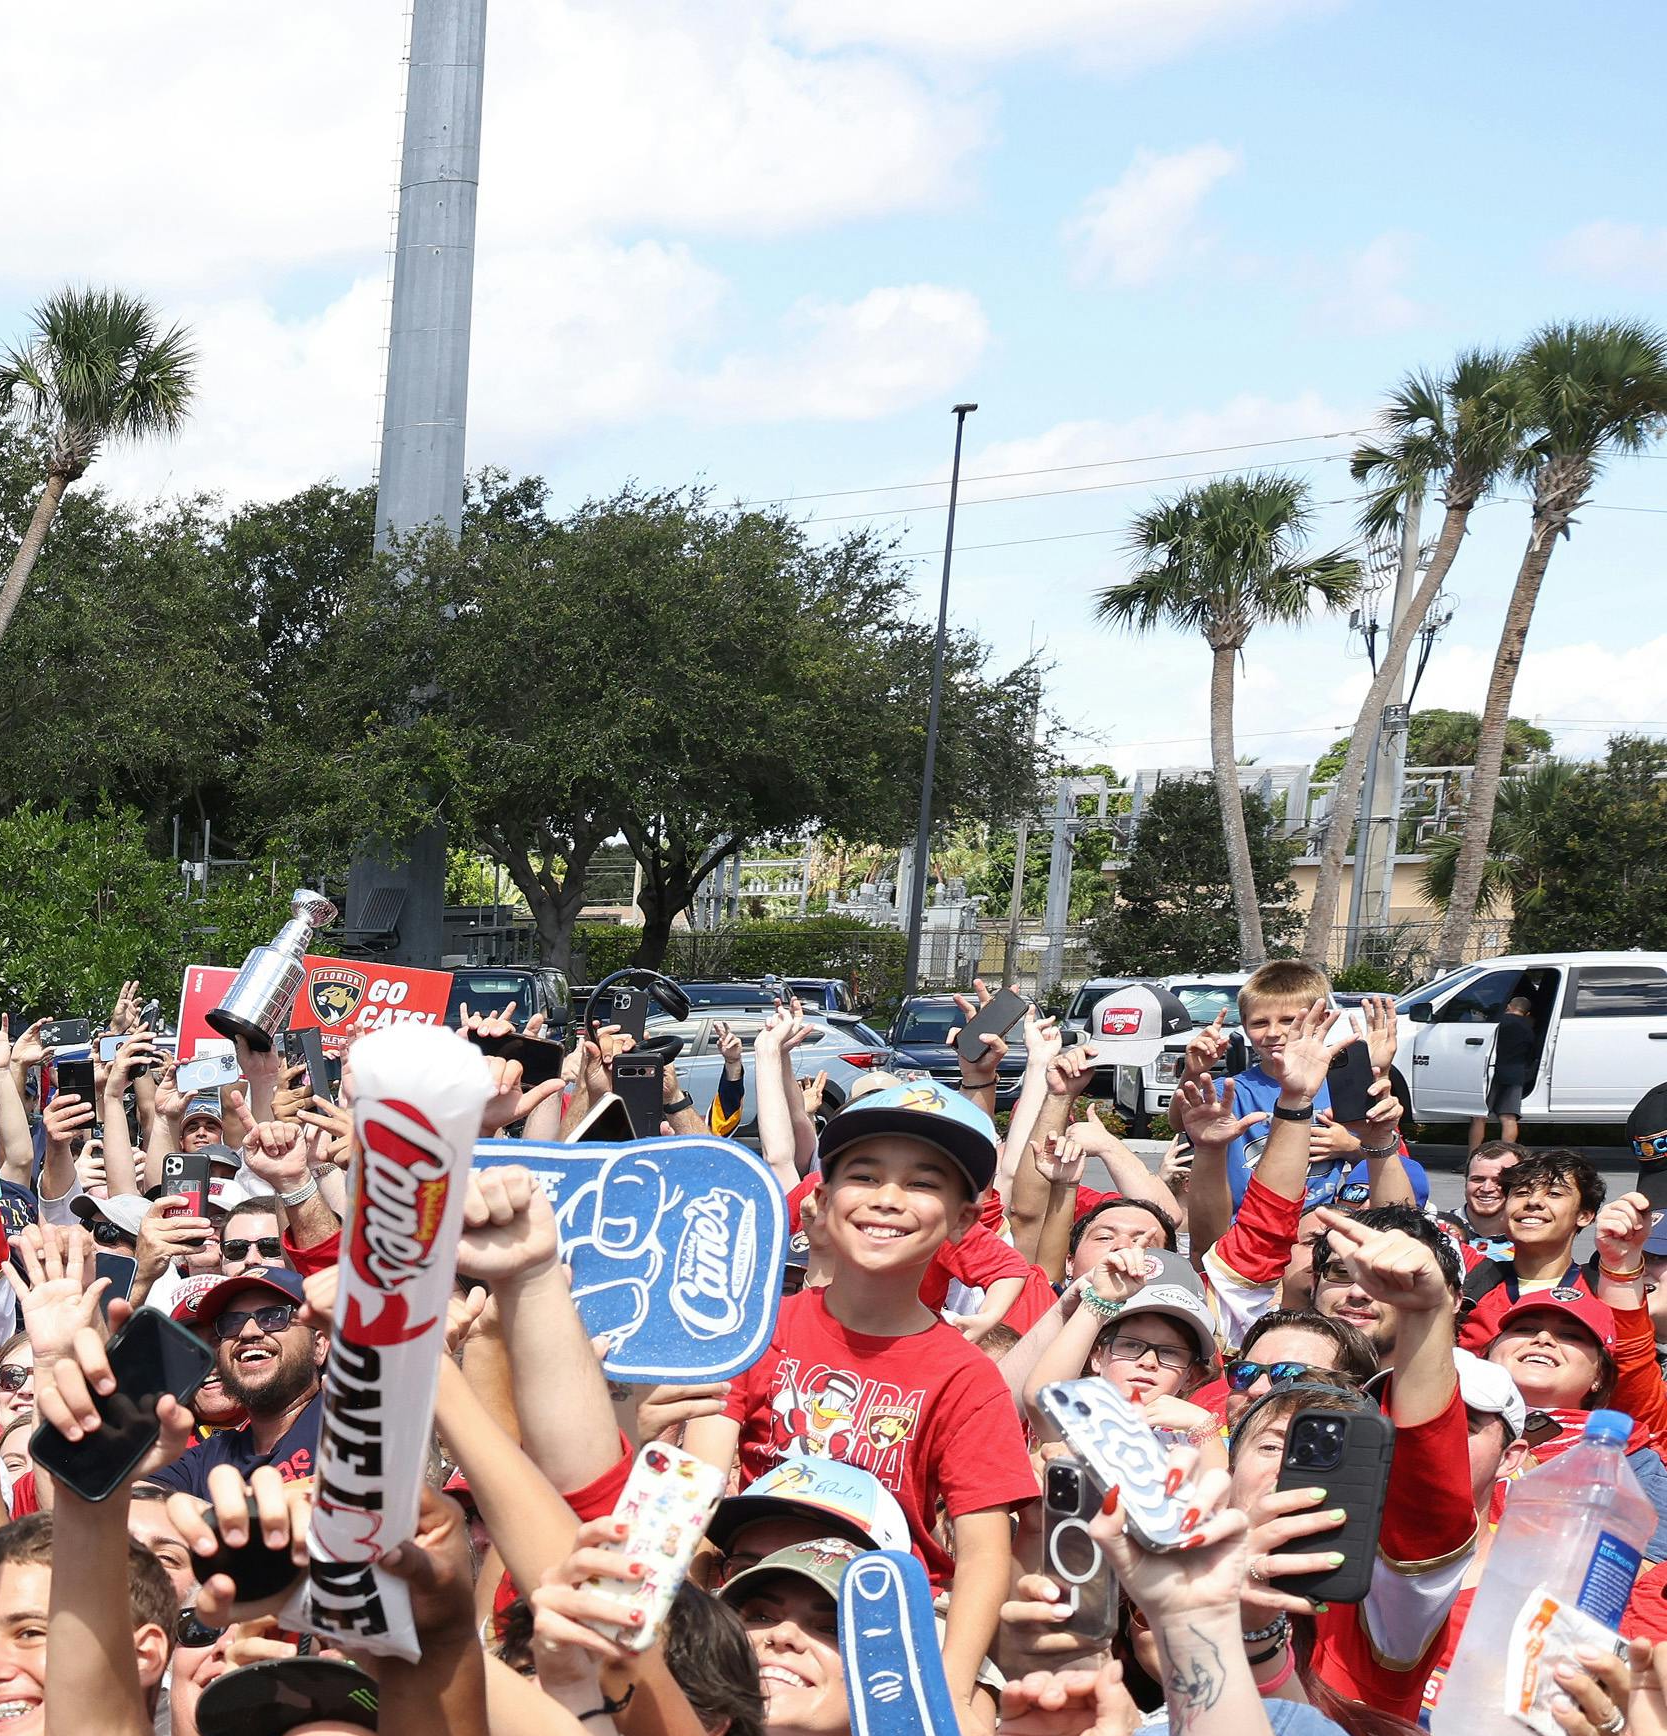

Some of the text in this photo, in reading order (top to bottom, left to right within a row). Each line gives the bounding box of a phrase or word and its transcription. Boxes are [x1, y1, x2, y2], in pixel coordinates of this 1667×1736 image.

[316, 971, 361, 985] FLORIDA
[367, 979, 410, 1004] GO
[354, 1098, 455, 1293] Cane's
[415, 1182, 446, 1242] Raising
[672, 1191, 738, 1333] Cane's
[679, 1231, 700, 1280] Raising
[1159, 1291, 1193, 1306] ALL OUT
[318, 1333, 383, 1477] ONE
